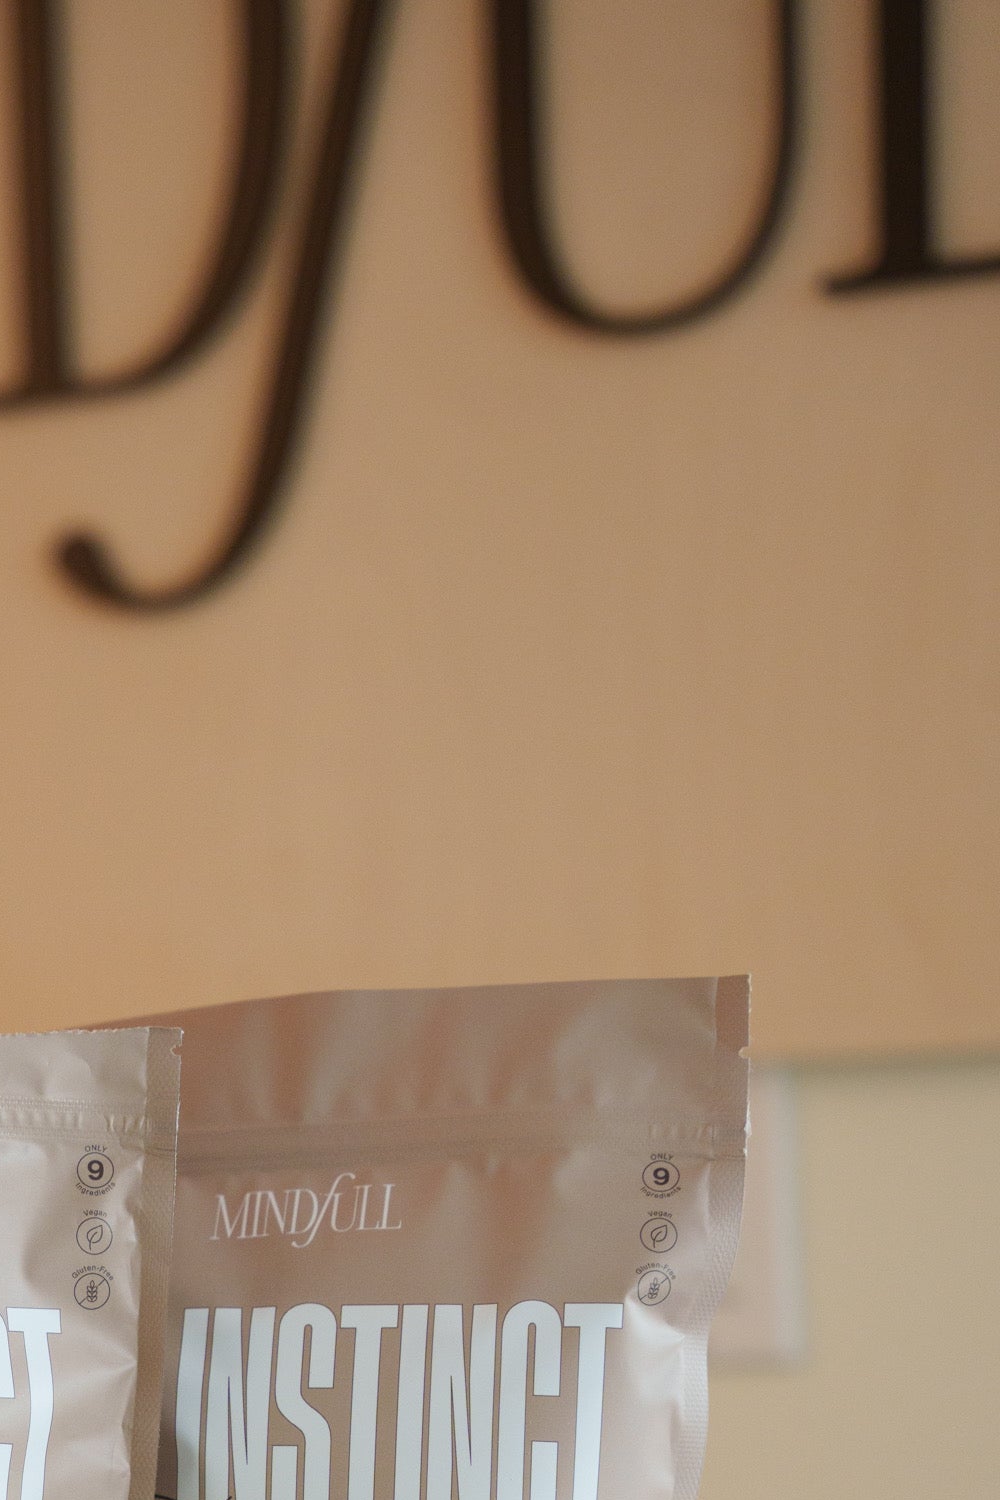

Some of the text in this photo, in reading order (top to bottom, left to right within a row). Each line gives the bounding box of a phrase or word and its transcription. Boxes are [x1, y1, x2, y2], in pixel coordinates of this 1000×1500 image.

[85, 1144, 107, 1153] ONLY
[650, 1153, 674, 1161] ONLY
[87, 1159, 104, 1181] 9
[653, 1167, 670, 1185] 9
[83, 1209, 108, 1217] Vegan
[648, 1210, 673, 1219] Vegan
[71, 1265, 114, 1281] Gluten-Free
[635, 1262, 676, 1280] Gluten-Free
